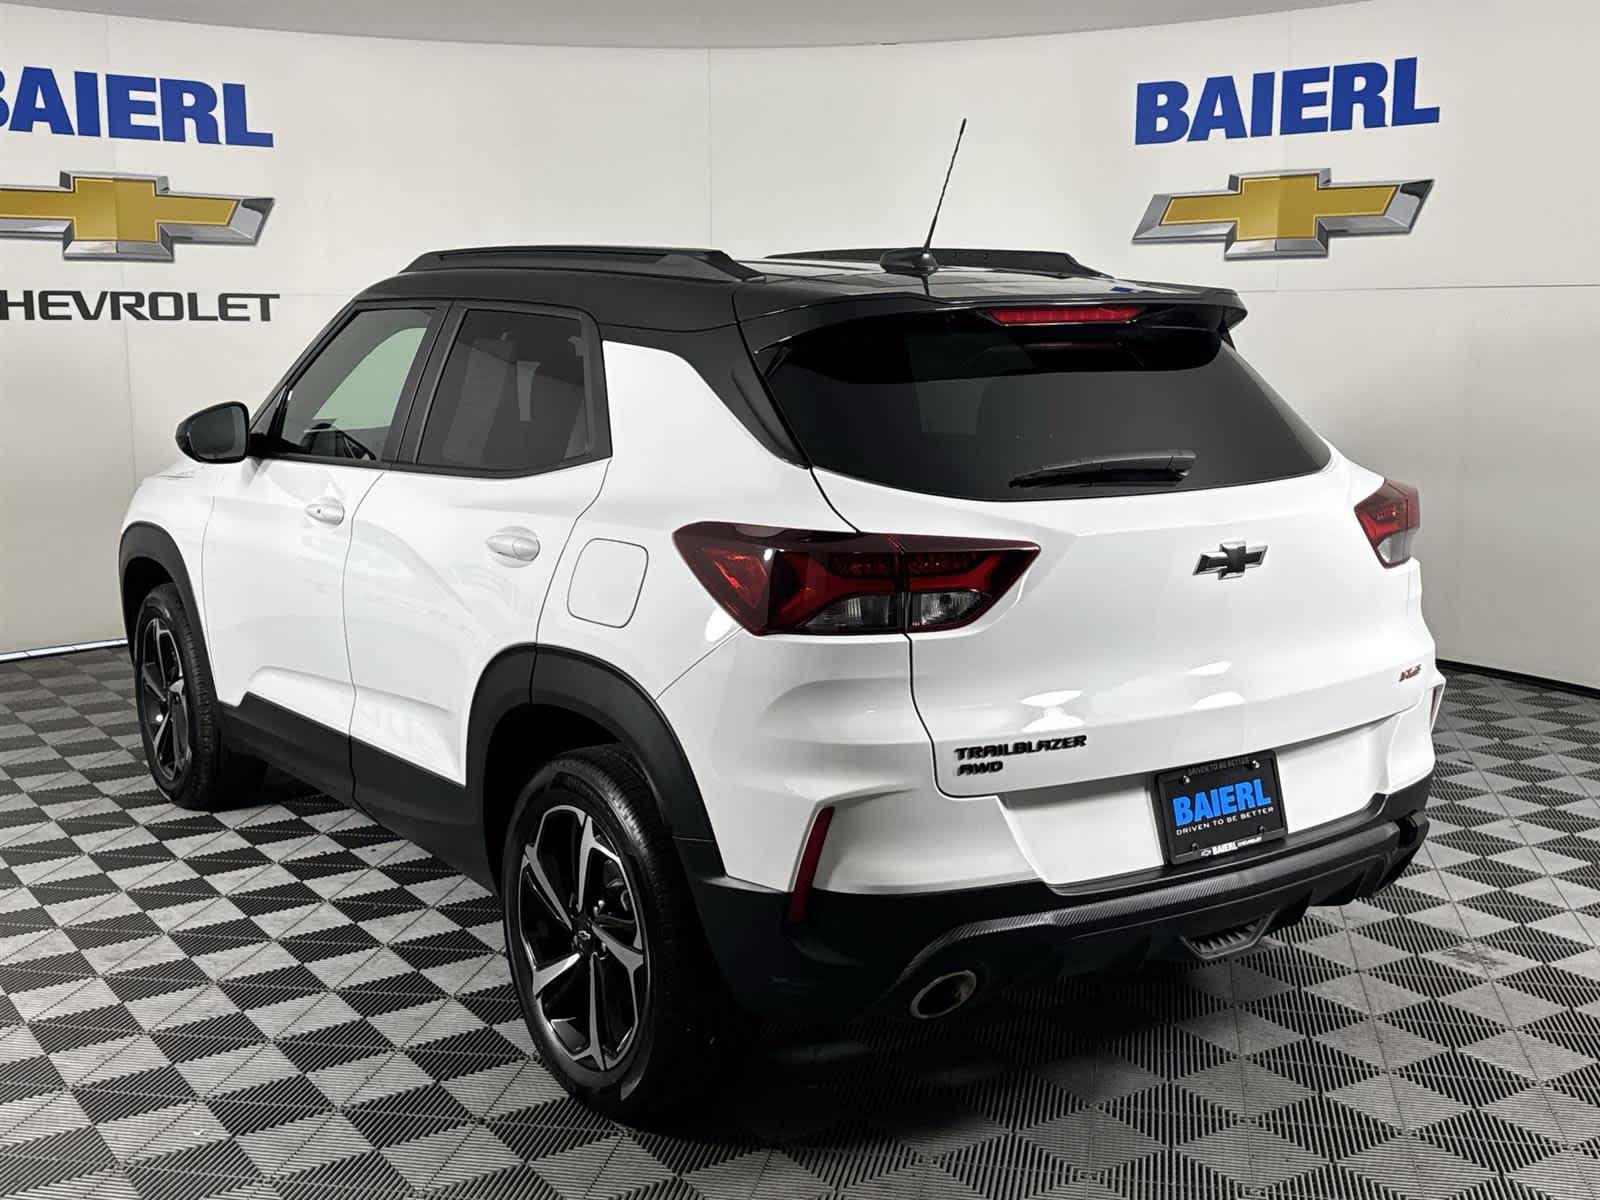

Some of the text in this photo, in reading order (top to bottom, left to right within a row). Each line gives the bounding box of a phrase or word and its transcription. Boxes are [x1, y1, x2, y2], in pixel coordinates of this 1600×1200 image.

[0, 66, 274, 147] AIERL
[1135, 56, 1440, 145] BAIERL
[0, 290, 280, 321] HEVROLET
[954, 735, 1087, 760] TRAILBLAZER
[957, 761, 1003, 776] AWD
[1172, 779, 1271, 827] BAIERL
[1176, 823, 1210, 836] DRIVEN
[1212, 818, 1224, 826] TO
[1240, 807, 1274, 820] BETTER
[1212, 841, 1238, 855] BAIERL
